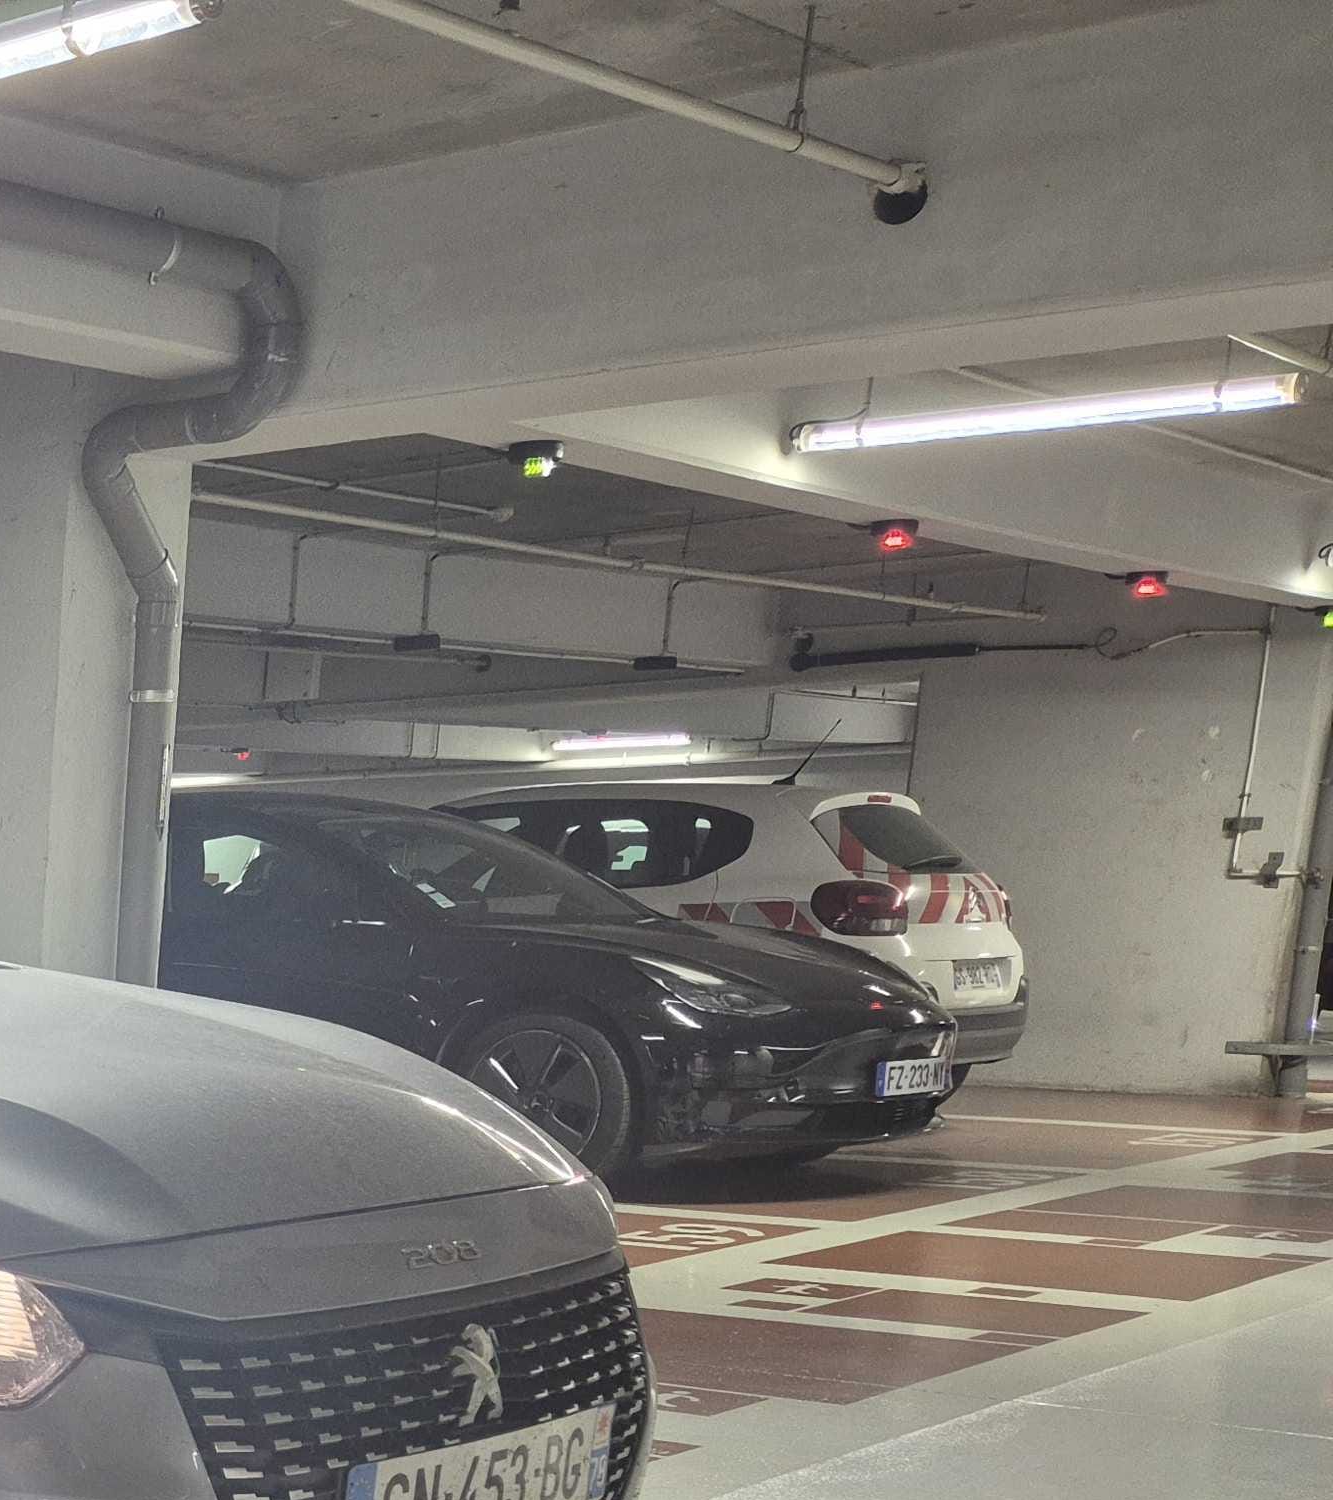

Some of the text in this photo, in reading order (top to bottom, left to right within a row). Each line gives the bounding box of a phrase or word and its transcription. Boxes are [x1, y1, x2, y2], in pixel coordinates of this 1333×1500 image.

[1127, 1132, 1253, 1148] 157
[616, 1223, 766, 1251] 159
[401, 1239, 482, 1270] 208
